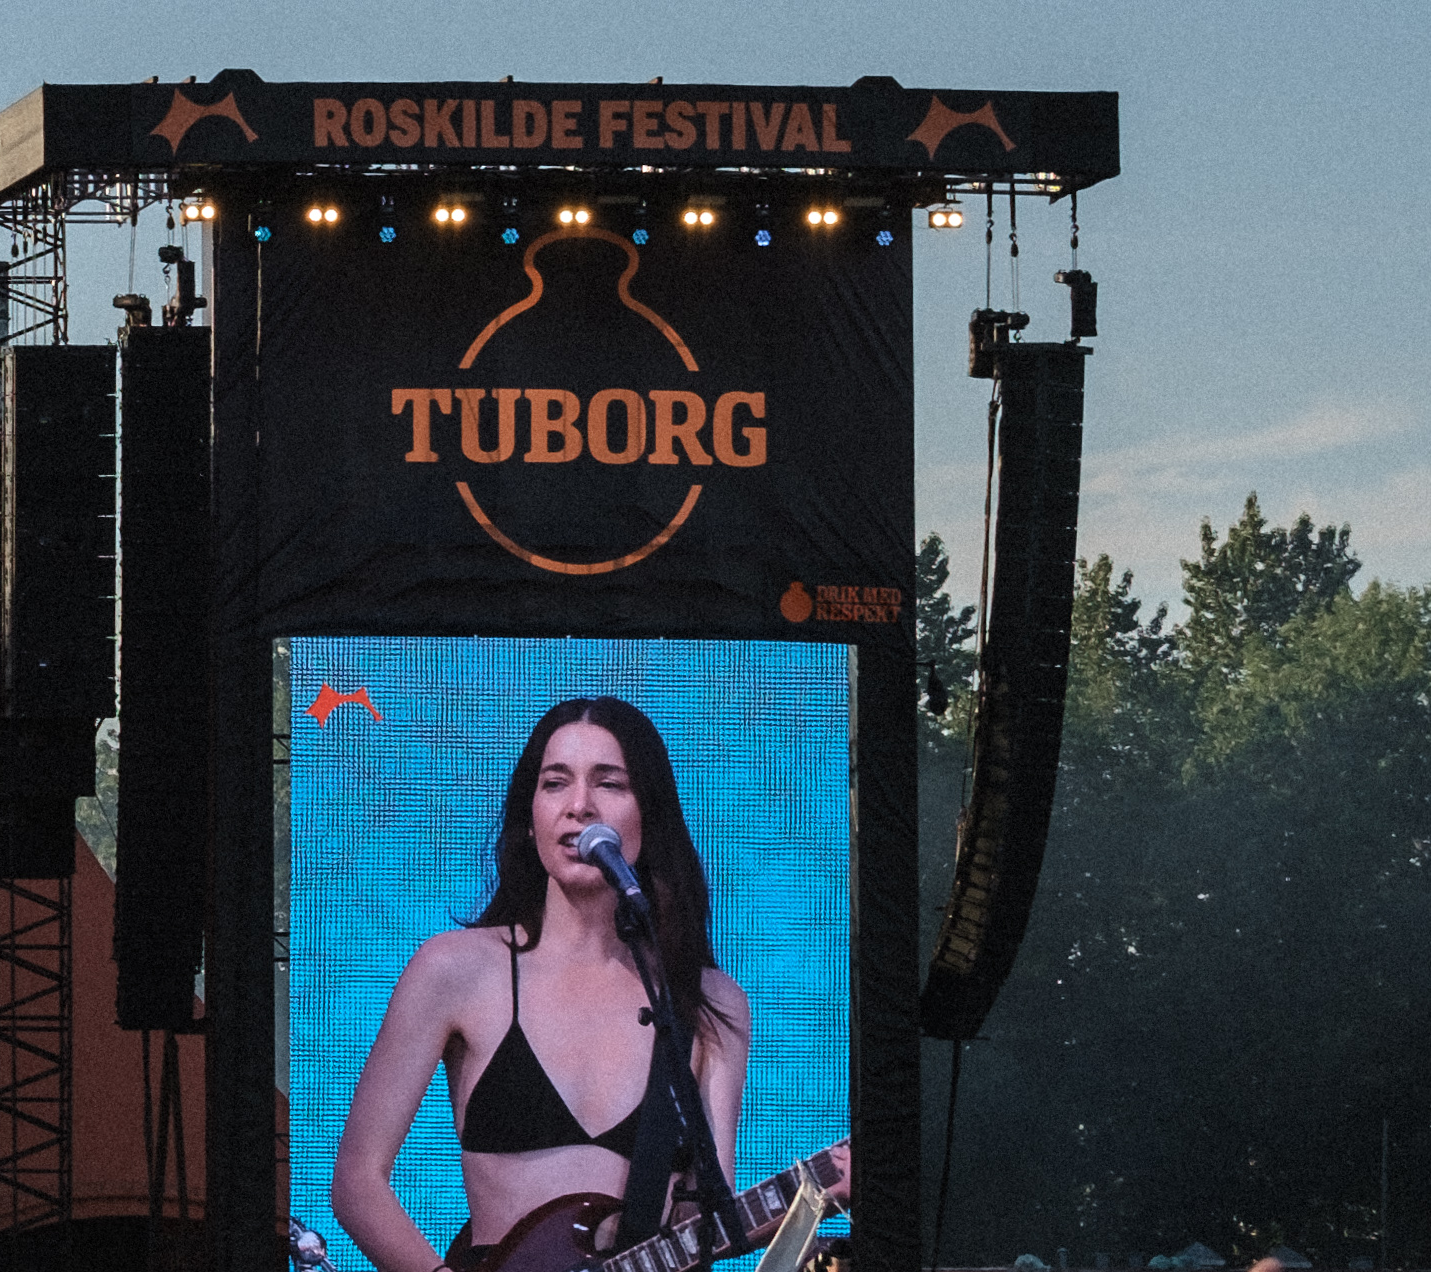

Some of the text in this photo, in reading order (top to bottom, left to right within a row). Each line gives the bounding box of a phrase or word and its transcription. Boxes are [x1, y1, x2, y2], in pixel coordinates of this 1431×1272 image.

[313, 97, 852, 153] ROSKILDE FESTIVAL
[391, 388, 767, 468] TUBORG
[815, 603, 902, 623] RESPEKT
[816, 585, 902, 605] DRIK MED
